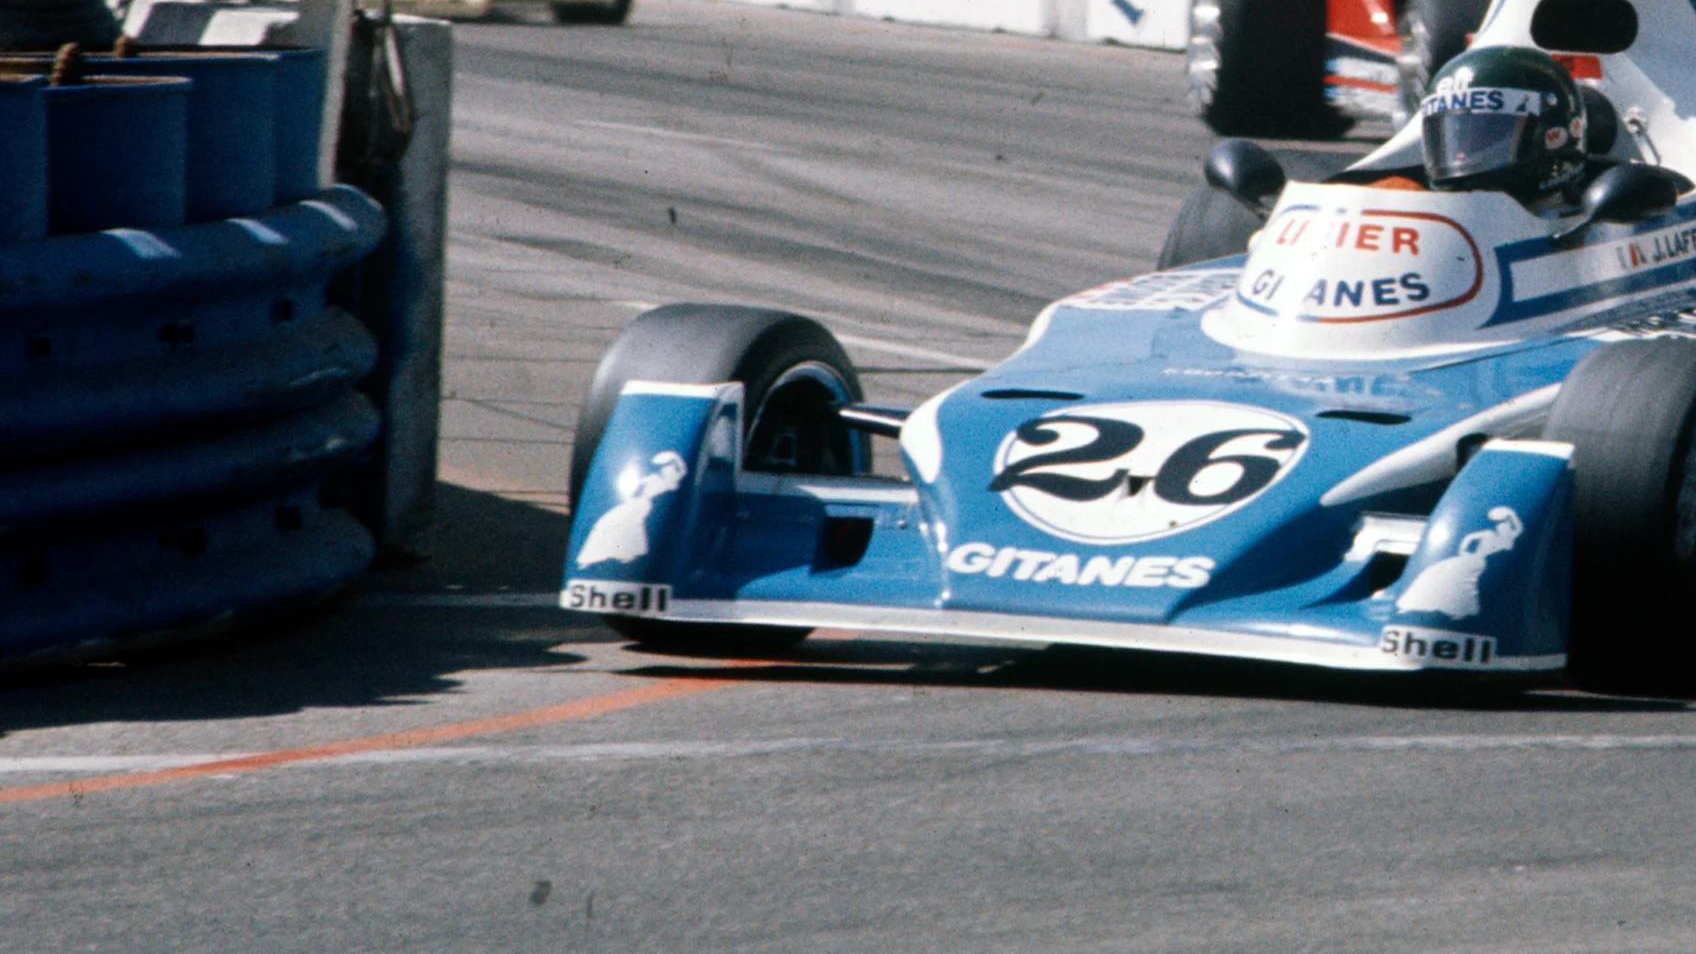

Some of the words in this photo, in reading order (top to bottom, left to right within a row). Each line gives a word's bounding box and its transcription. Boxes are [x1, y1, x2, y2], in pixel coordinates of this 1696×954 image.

[1274, 219, 1421, 256] LIIER
[1250, 271, 1431, 308] GIANES
[987, 415, 1308, 506] 26
[947, 542, 1216, 590] GITANES
[568, 583, 668, 611] Shell
[1381, 628, 1493, 663] Shell
